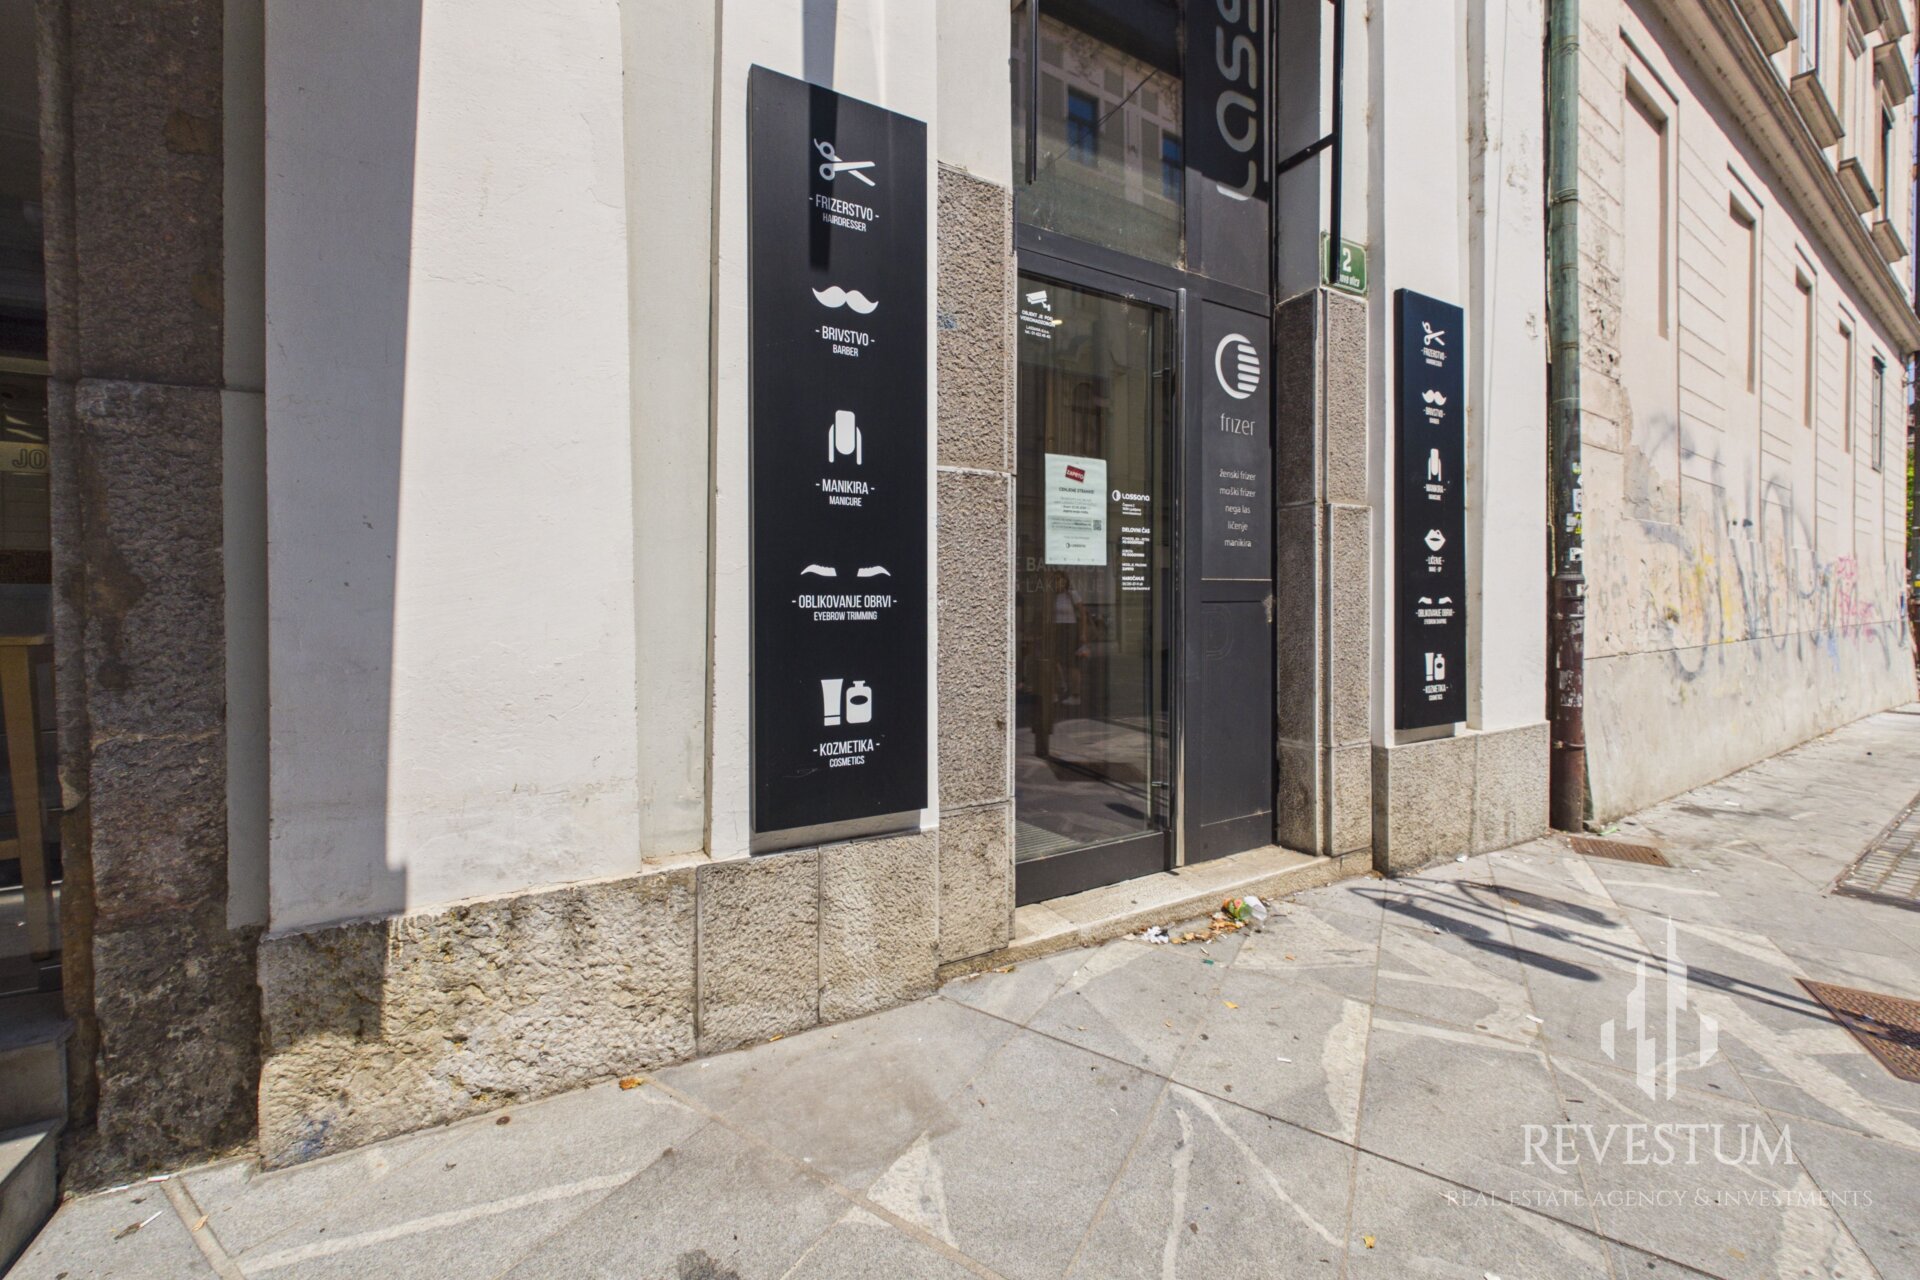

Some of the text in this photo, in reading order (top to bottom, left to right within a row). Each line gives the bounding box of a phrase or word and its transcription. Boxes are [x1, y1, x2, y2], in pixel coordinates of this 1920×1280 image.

[815, 194, 874, 221] FRIZERSTVO
[822, 212, 867, 232] HAIRDRESSER
[1342, 247, 1352, 273] 2
[821, 325, 869, 346] BRIVSTVO
[832, 344, 859, 357] BARBER
[1220, 412, 1256, 436] frizer
[1219, 468, 1257, 481] ženski frizer
[822, 479, 869, 495] MANIKIRA
[1219, 486, 1256, 498] moški frizer
[829, 495, 862, 507] MANICURE
[1225, 504, 1251, 515] nega las
[1227, 520, 1249, 532] ličenje
[1224, 537, 1252, 548] manikira
[798, 595, 892, 609] OBLIKOVANJE OBRVI
[813, 610, 878, 621] EYEBROW TRIMMING
[819, 738, 875, 757] KOZMETIKA
[829, 755, 865, 768] COSMETICS
